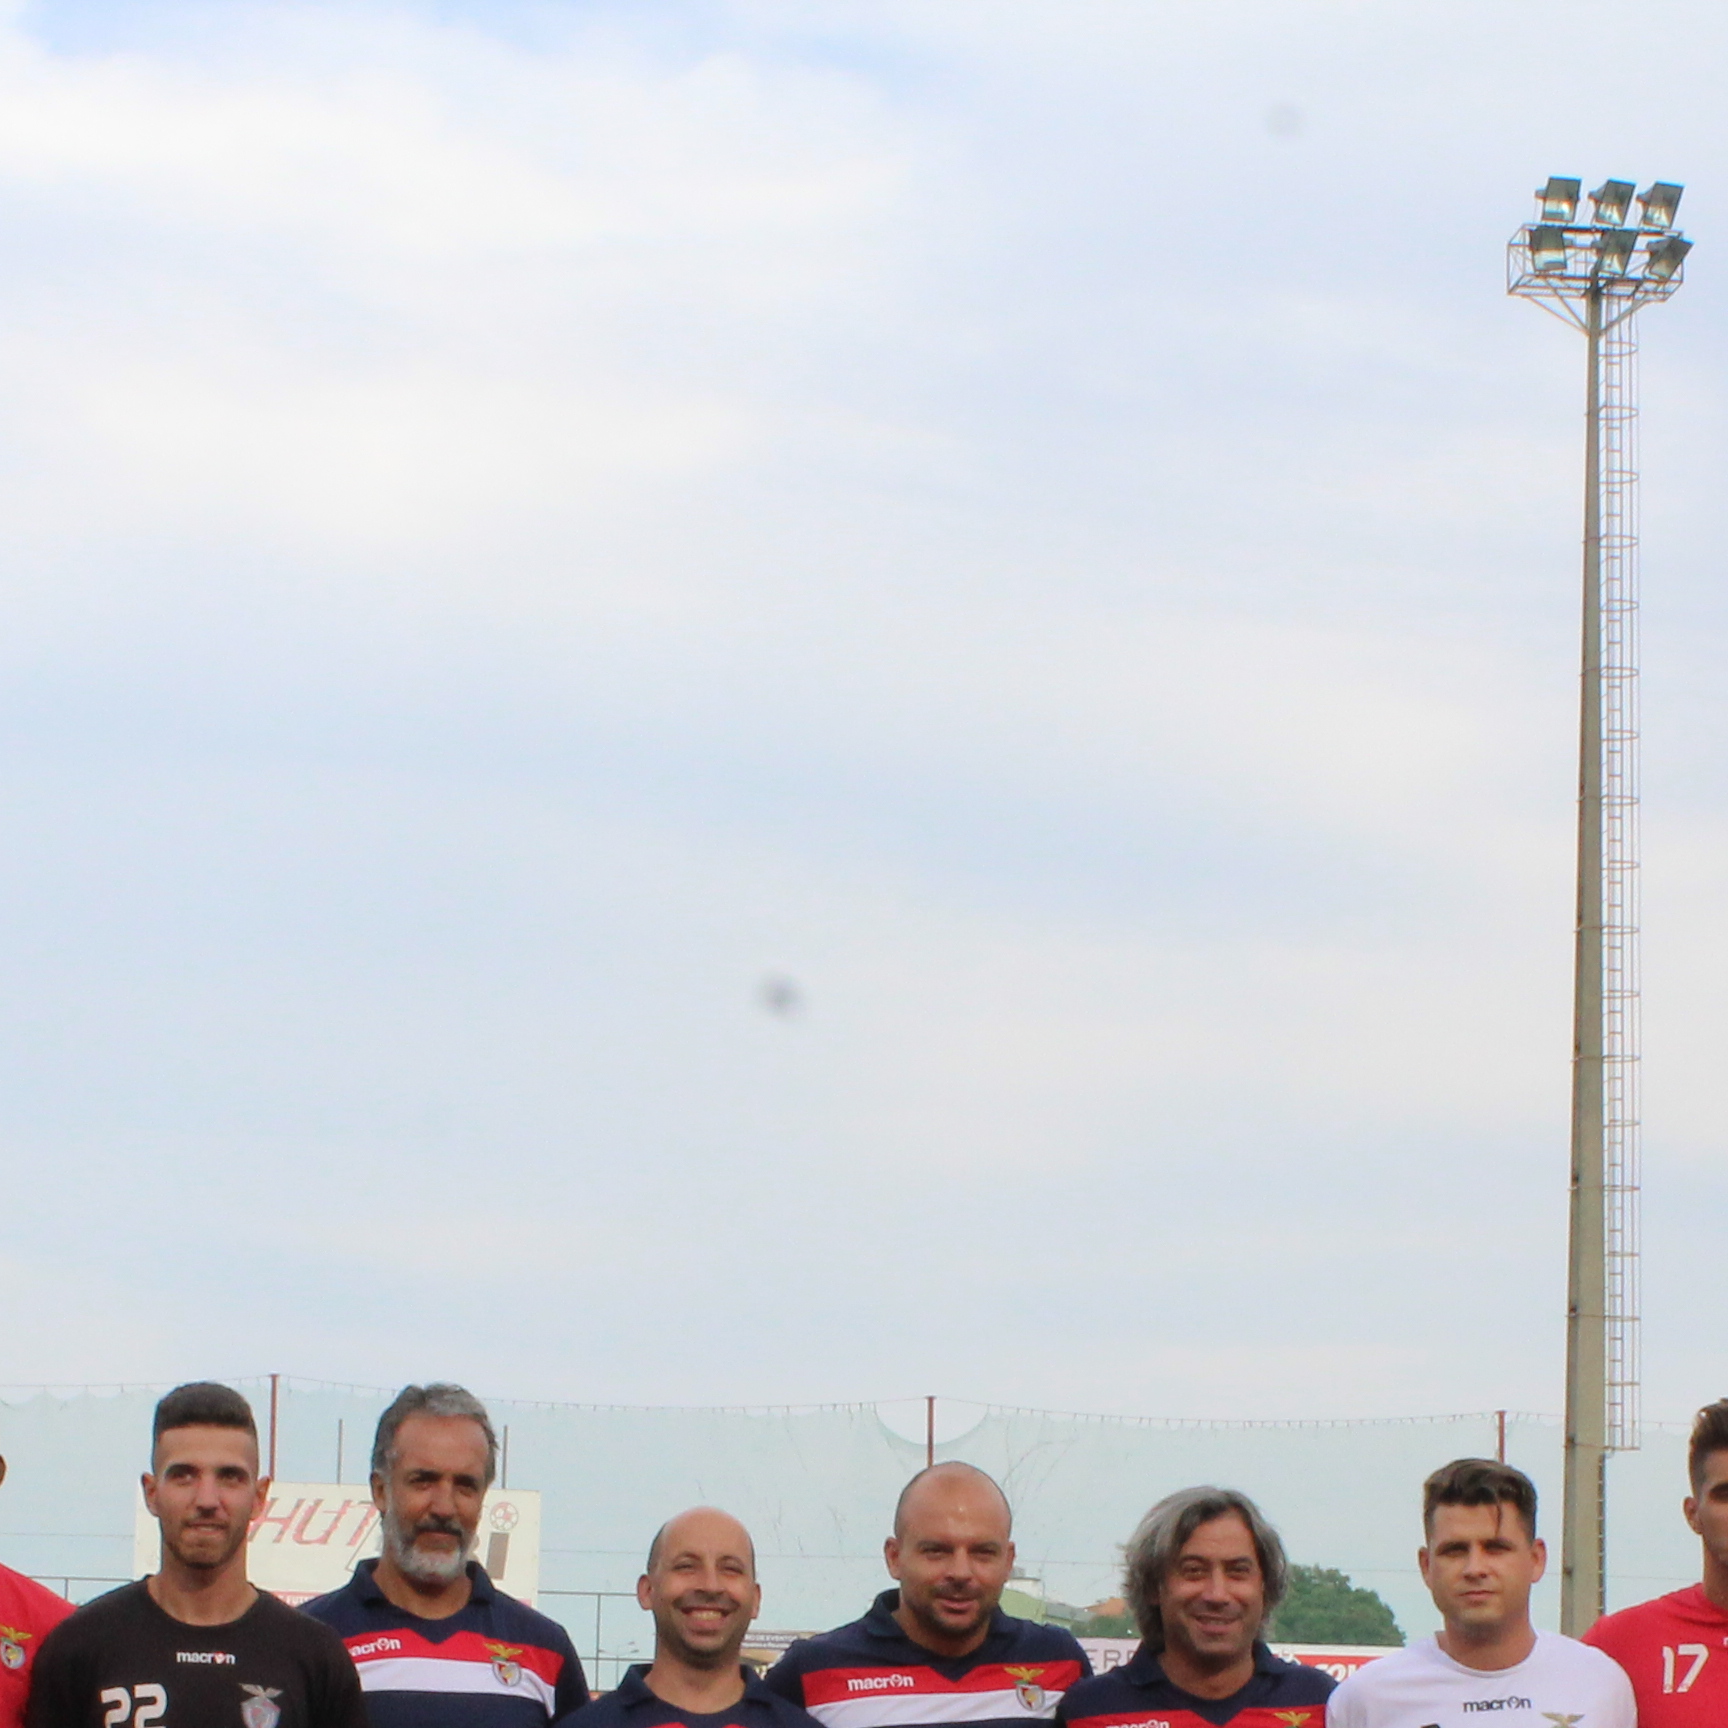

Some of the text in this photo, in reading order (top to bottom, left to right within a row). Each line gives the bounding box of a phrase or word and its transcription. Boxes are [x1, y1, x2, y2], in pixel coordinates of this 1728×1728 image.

[349, 1637, 401, 1658] acron
[177, 1652, 235, 1664] macron
[1663, 1644, 1709, 1693] 17
[848, 1674, 914, 1691] macron
[1463, 1696, 1531, 1712] macron
